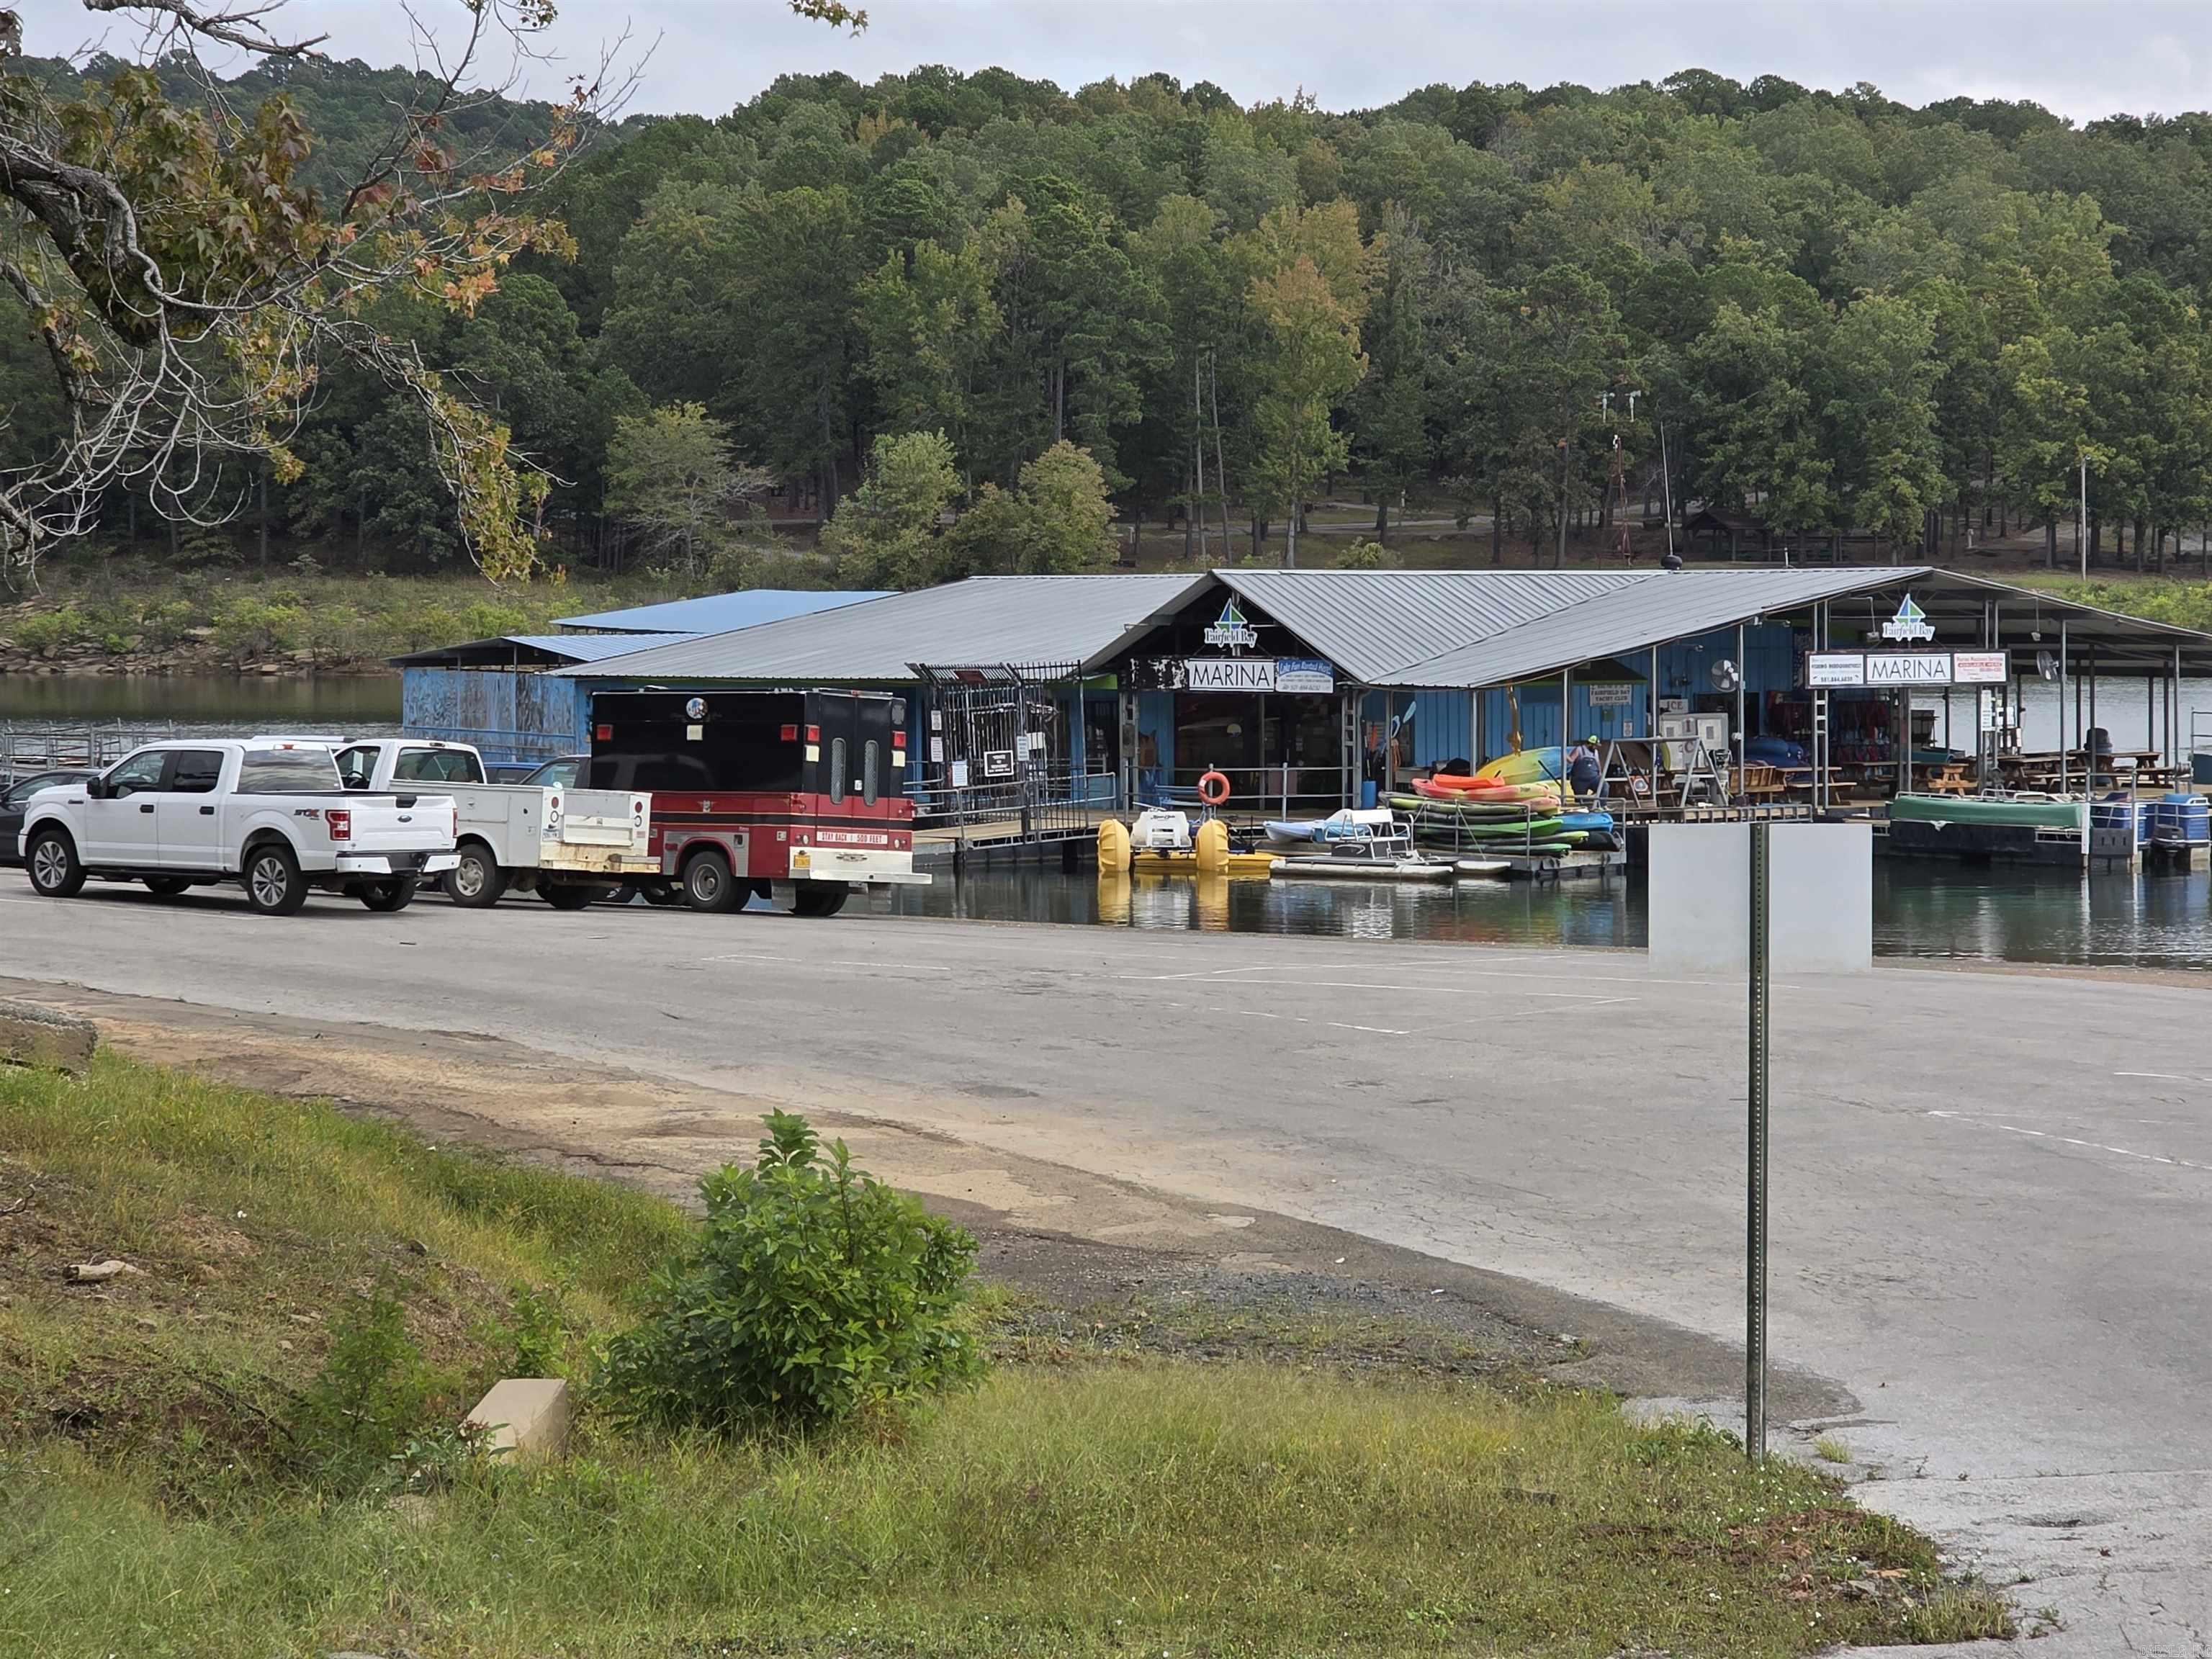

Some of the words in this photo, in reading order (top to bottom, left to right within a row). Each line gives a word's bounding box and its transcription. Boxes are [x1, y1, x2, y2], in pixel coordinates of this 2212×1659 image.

[1206, 629, 1239, 647] Fairfield
[1241, 629, 1256, 647] Bay
[1884, 623, 1917, 640] Fairfield
[1919, 623, 1935, 640] Bay
[1192, 664, 1270, 687] MARINA
[1871, 659, 1946, 679] MARINA
[1666, 701, 1683, 710] ICE
[822, 832, 834, 841] STAY
[835, 833, 848, 842] BACK
[869, 835, 882, 843] FEET
